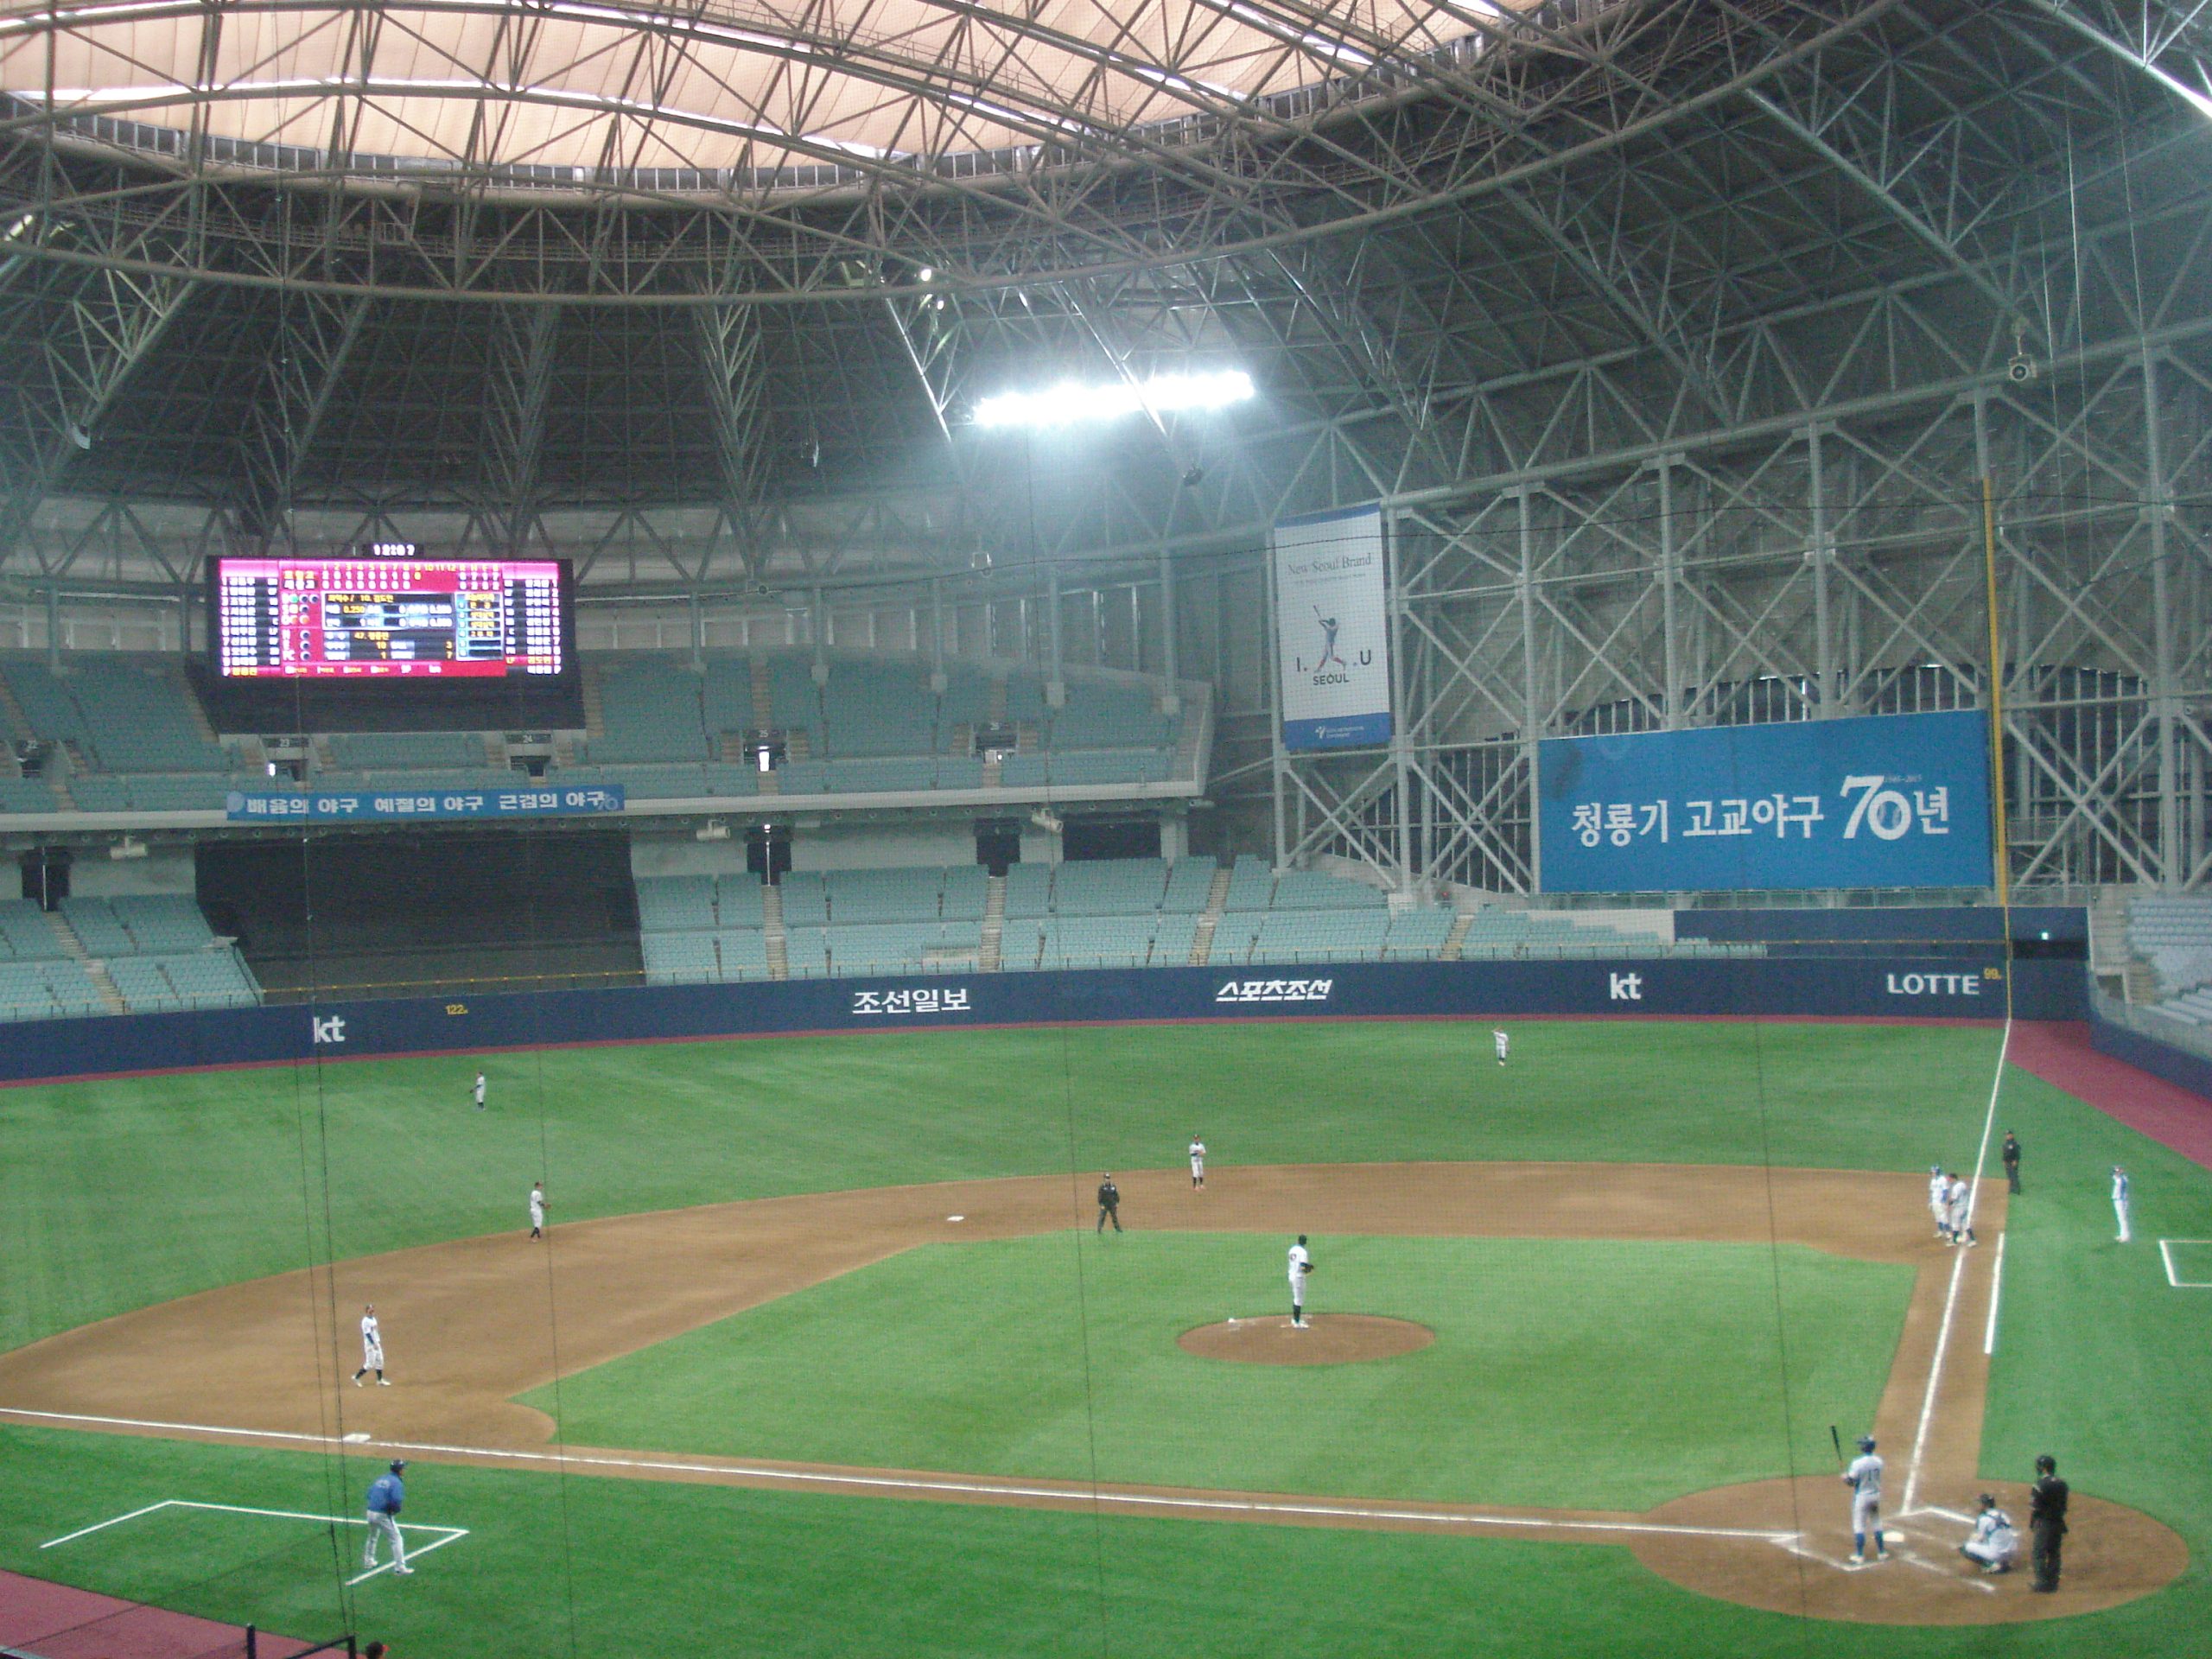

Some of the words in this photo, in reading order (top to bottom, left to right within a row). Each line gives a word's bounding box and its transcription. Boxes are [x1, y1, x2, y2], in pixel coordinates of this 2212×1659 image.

[1342, 553, 1371, 569] Brand
[1313, 674, 1350, 685] SEOUL
[318, 798, 359, 813] 야구
[443, 796, 484, 811] 야구
[565, 791, 605, 807] 야구
[1572, 799, 1669, 848] 청룡기
[1682, 793, 1825, 838] 고교야구
[1840, 775, 1949, 841] 70년
[1215, 979, 1332, 1002] 스포츠조선
[1610, 972, 1643, 1001] kt
[1887, 974, 1980, 995] LOTTE
[852, 988, 971, 1015] 조선일보
[313, 1016, 346, 1044] kt
